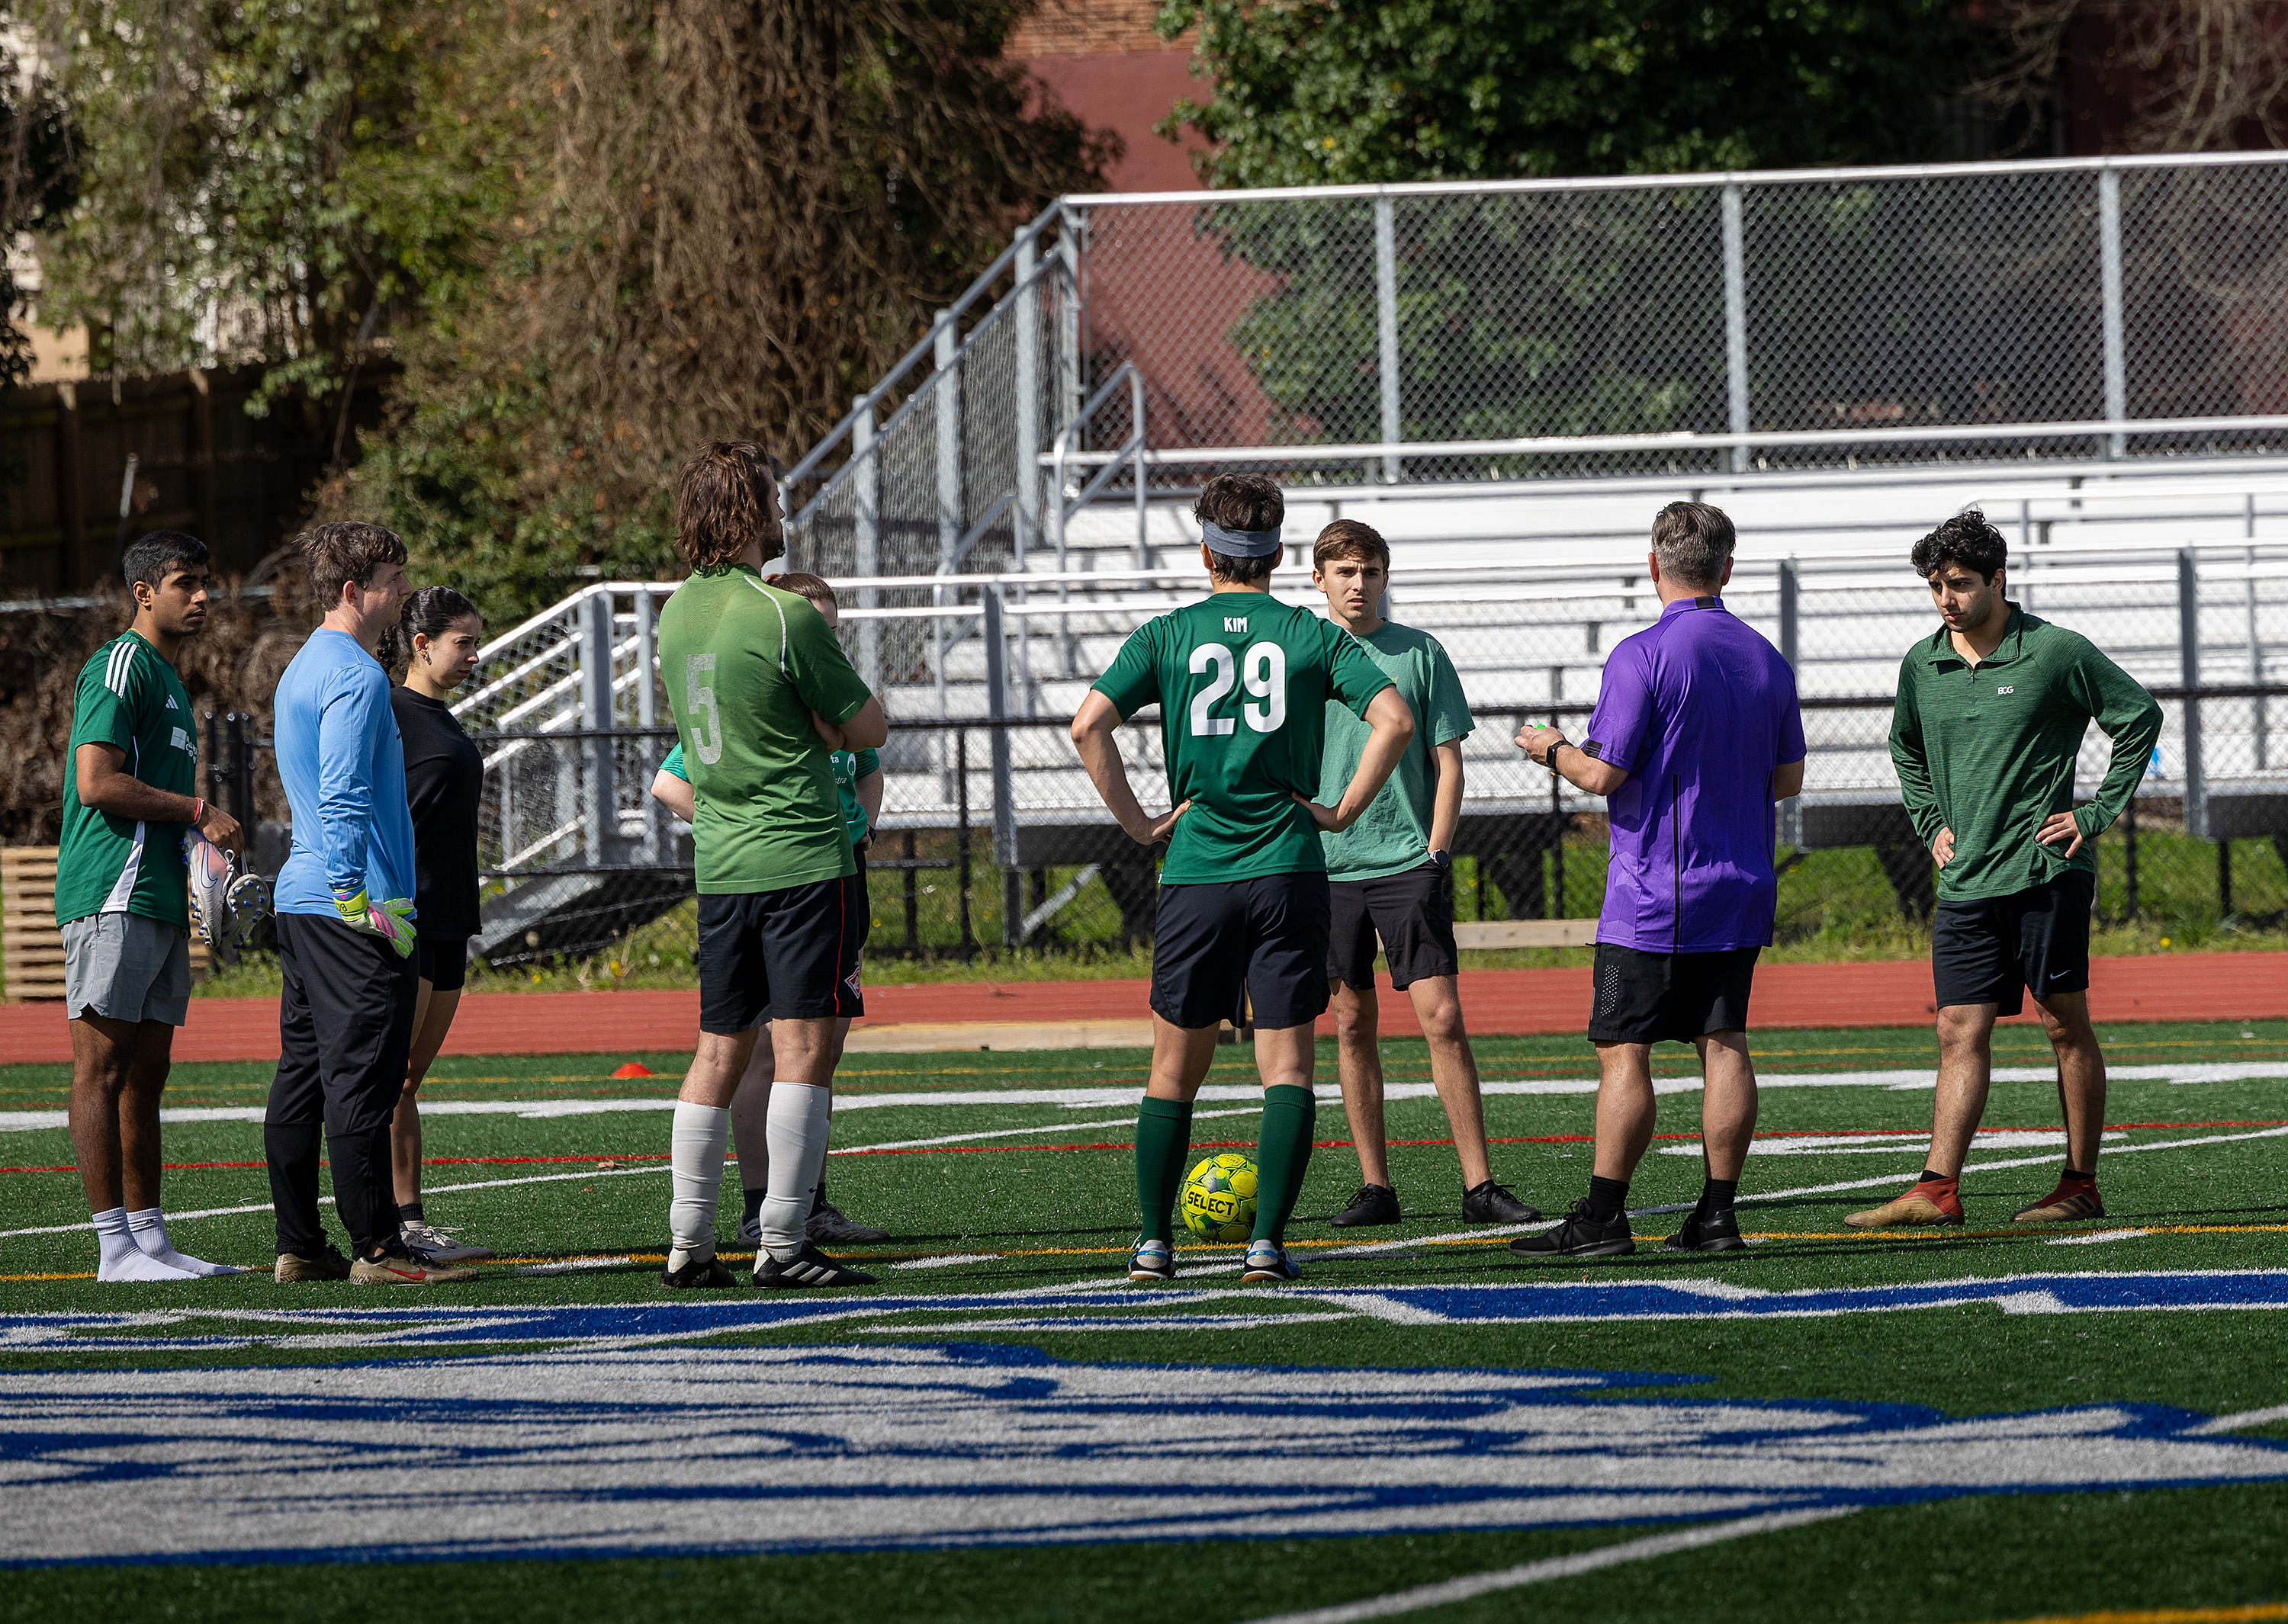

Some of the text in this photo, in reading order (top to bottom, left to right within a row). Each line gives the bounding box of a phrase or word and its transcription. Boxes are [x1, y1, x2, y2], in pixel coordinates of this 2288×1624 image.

[1224, 617, 1247, 632] KIM
[686, 653, 722, 765] 5
[1189, 641, 1286, 737] 29
[1187, 1191, 1235, 1216] SELECT
